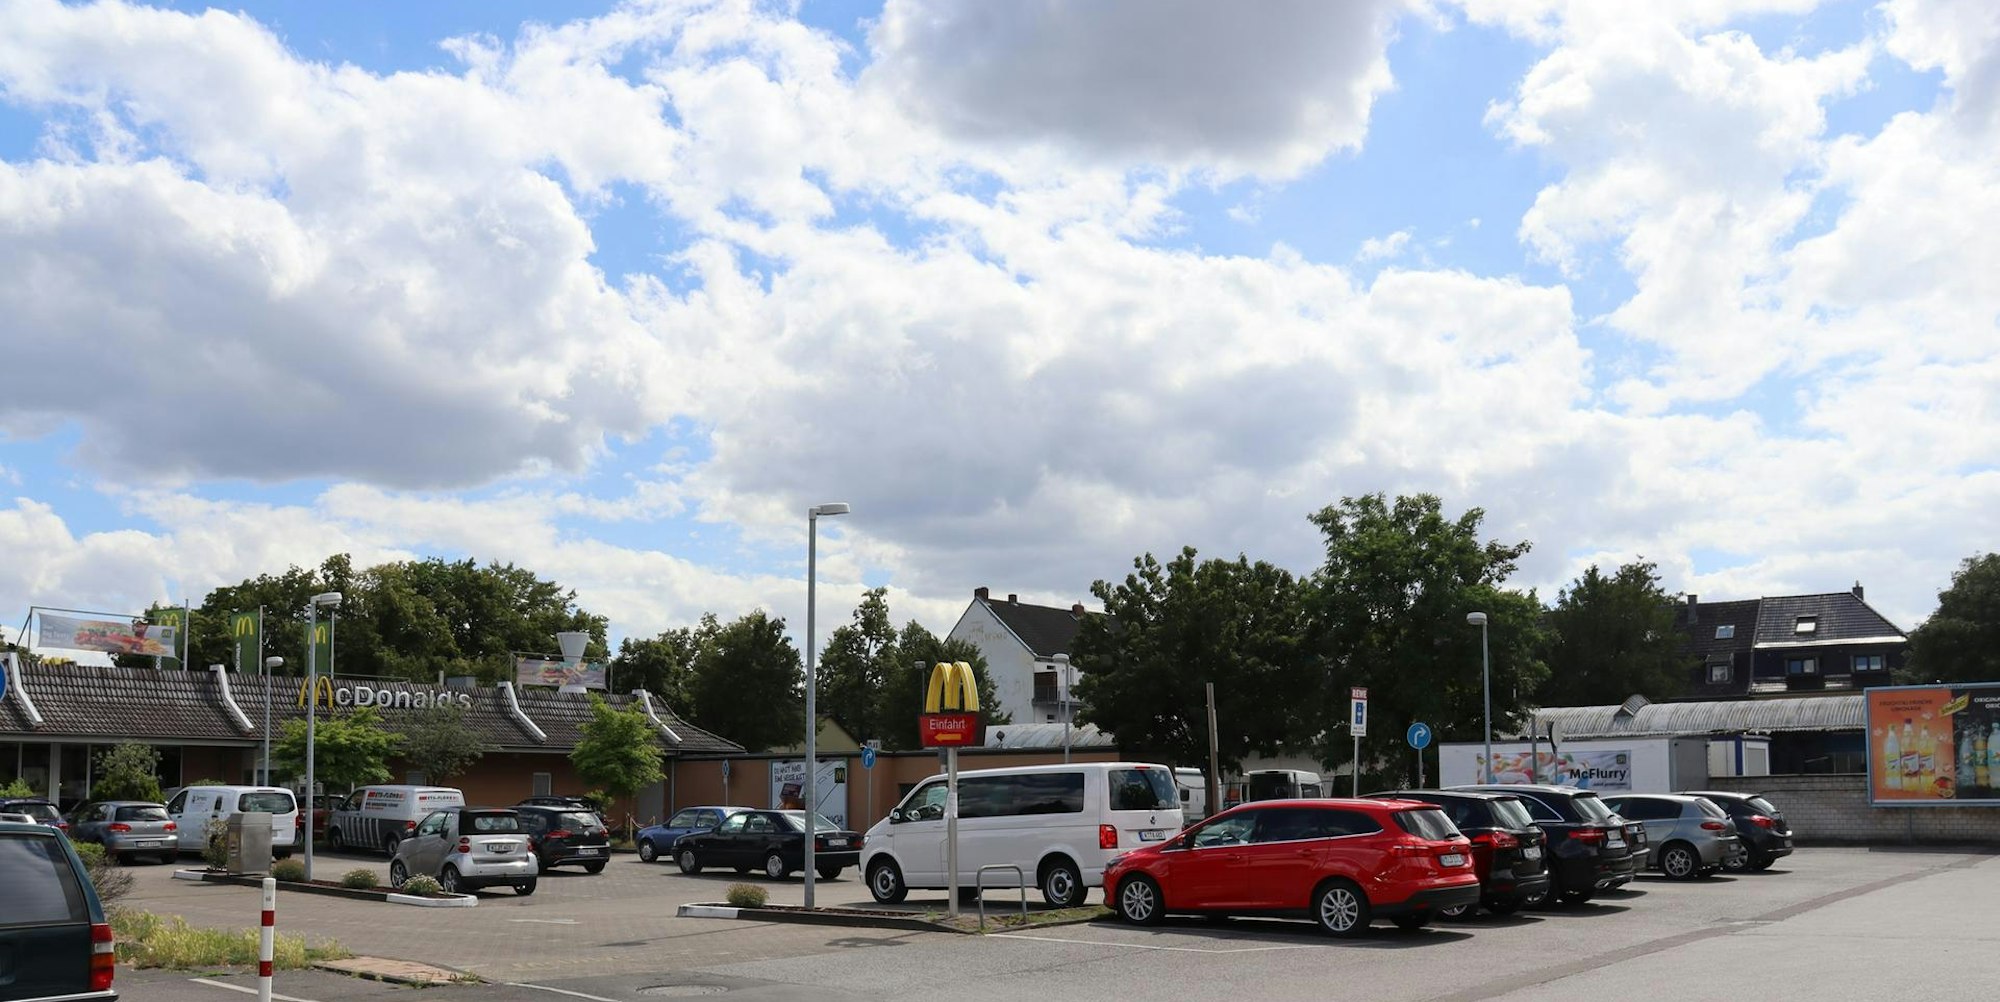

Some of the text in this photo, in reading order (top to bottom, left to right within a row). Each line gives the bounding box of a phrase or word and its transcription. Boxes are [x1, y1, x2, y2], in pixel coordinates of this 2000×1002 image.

[298, 675, 473, 710] McDonald's
[929, 718, 966, 730] Einfahrt
[1570, 768, 1627, 781] McFlurry
